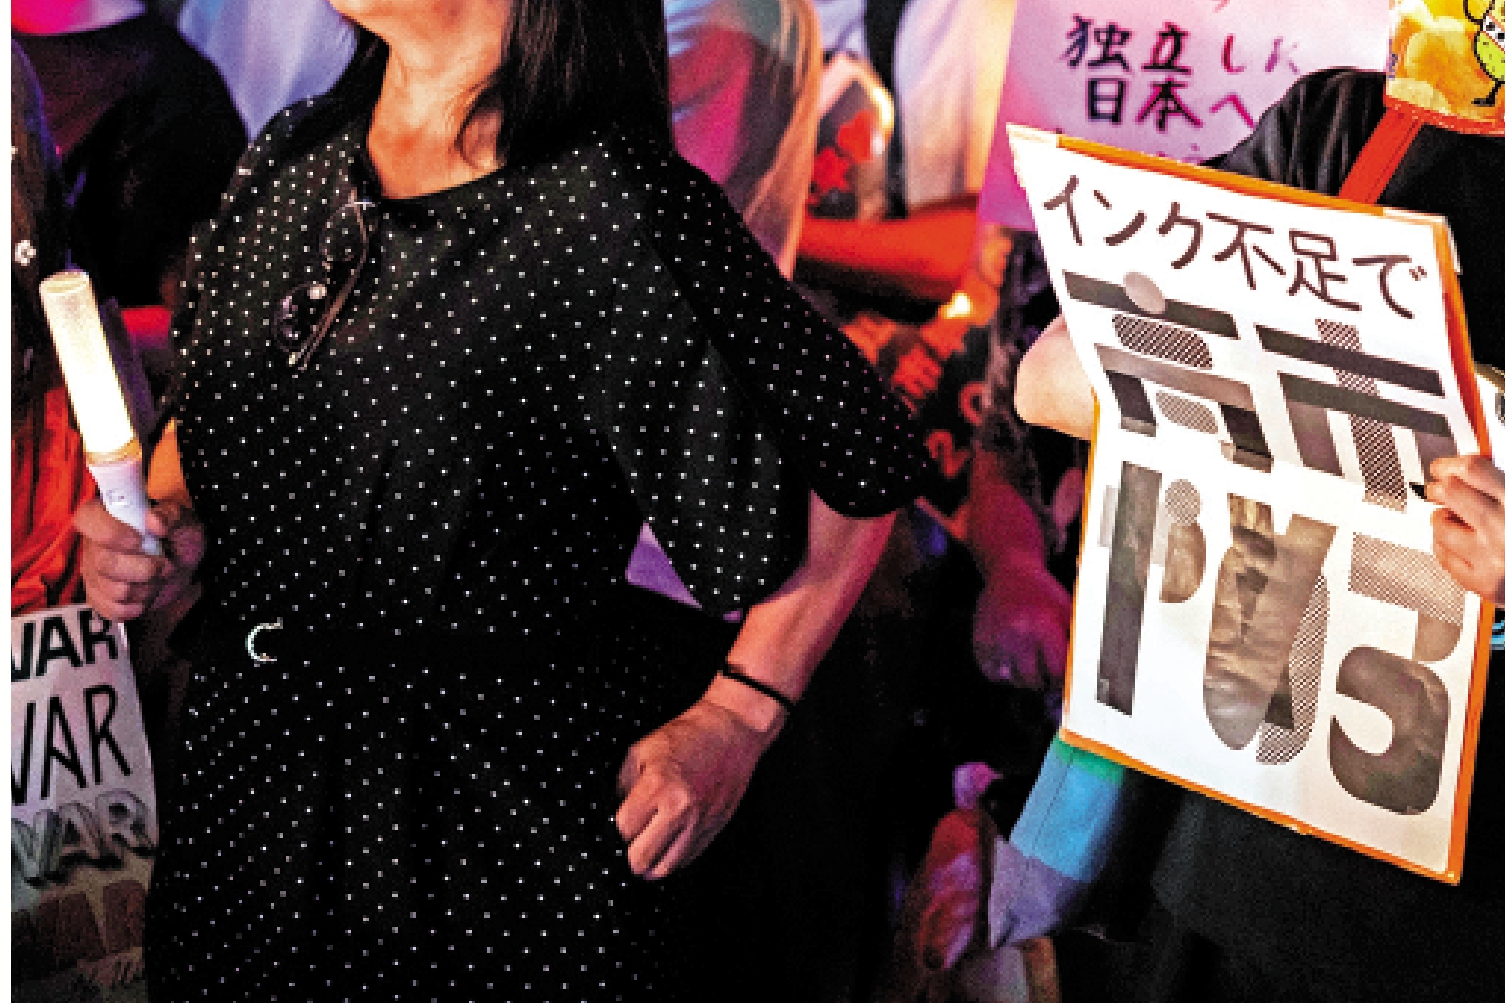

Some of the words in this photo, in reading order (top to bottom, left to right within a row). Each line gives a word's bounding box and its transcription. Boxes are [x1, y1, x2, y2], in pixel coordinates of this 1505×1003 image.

[1060, 13, 1301, 75] 独立した
[1086, 77, 1256, 133] 日本へ
[1043, 174, 1428, 320] インク不足で
